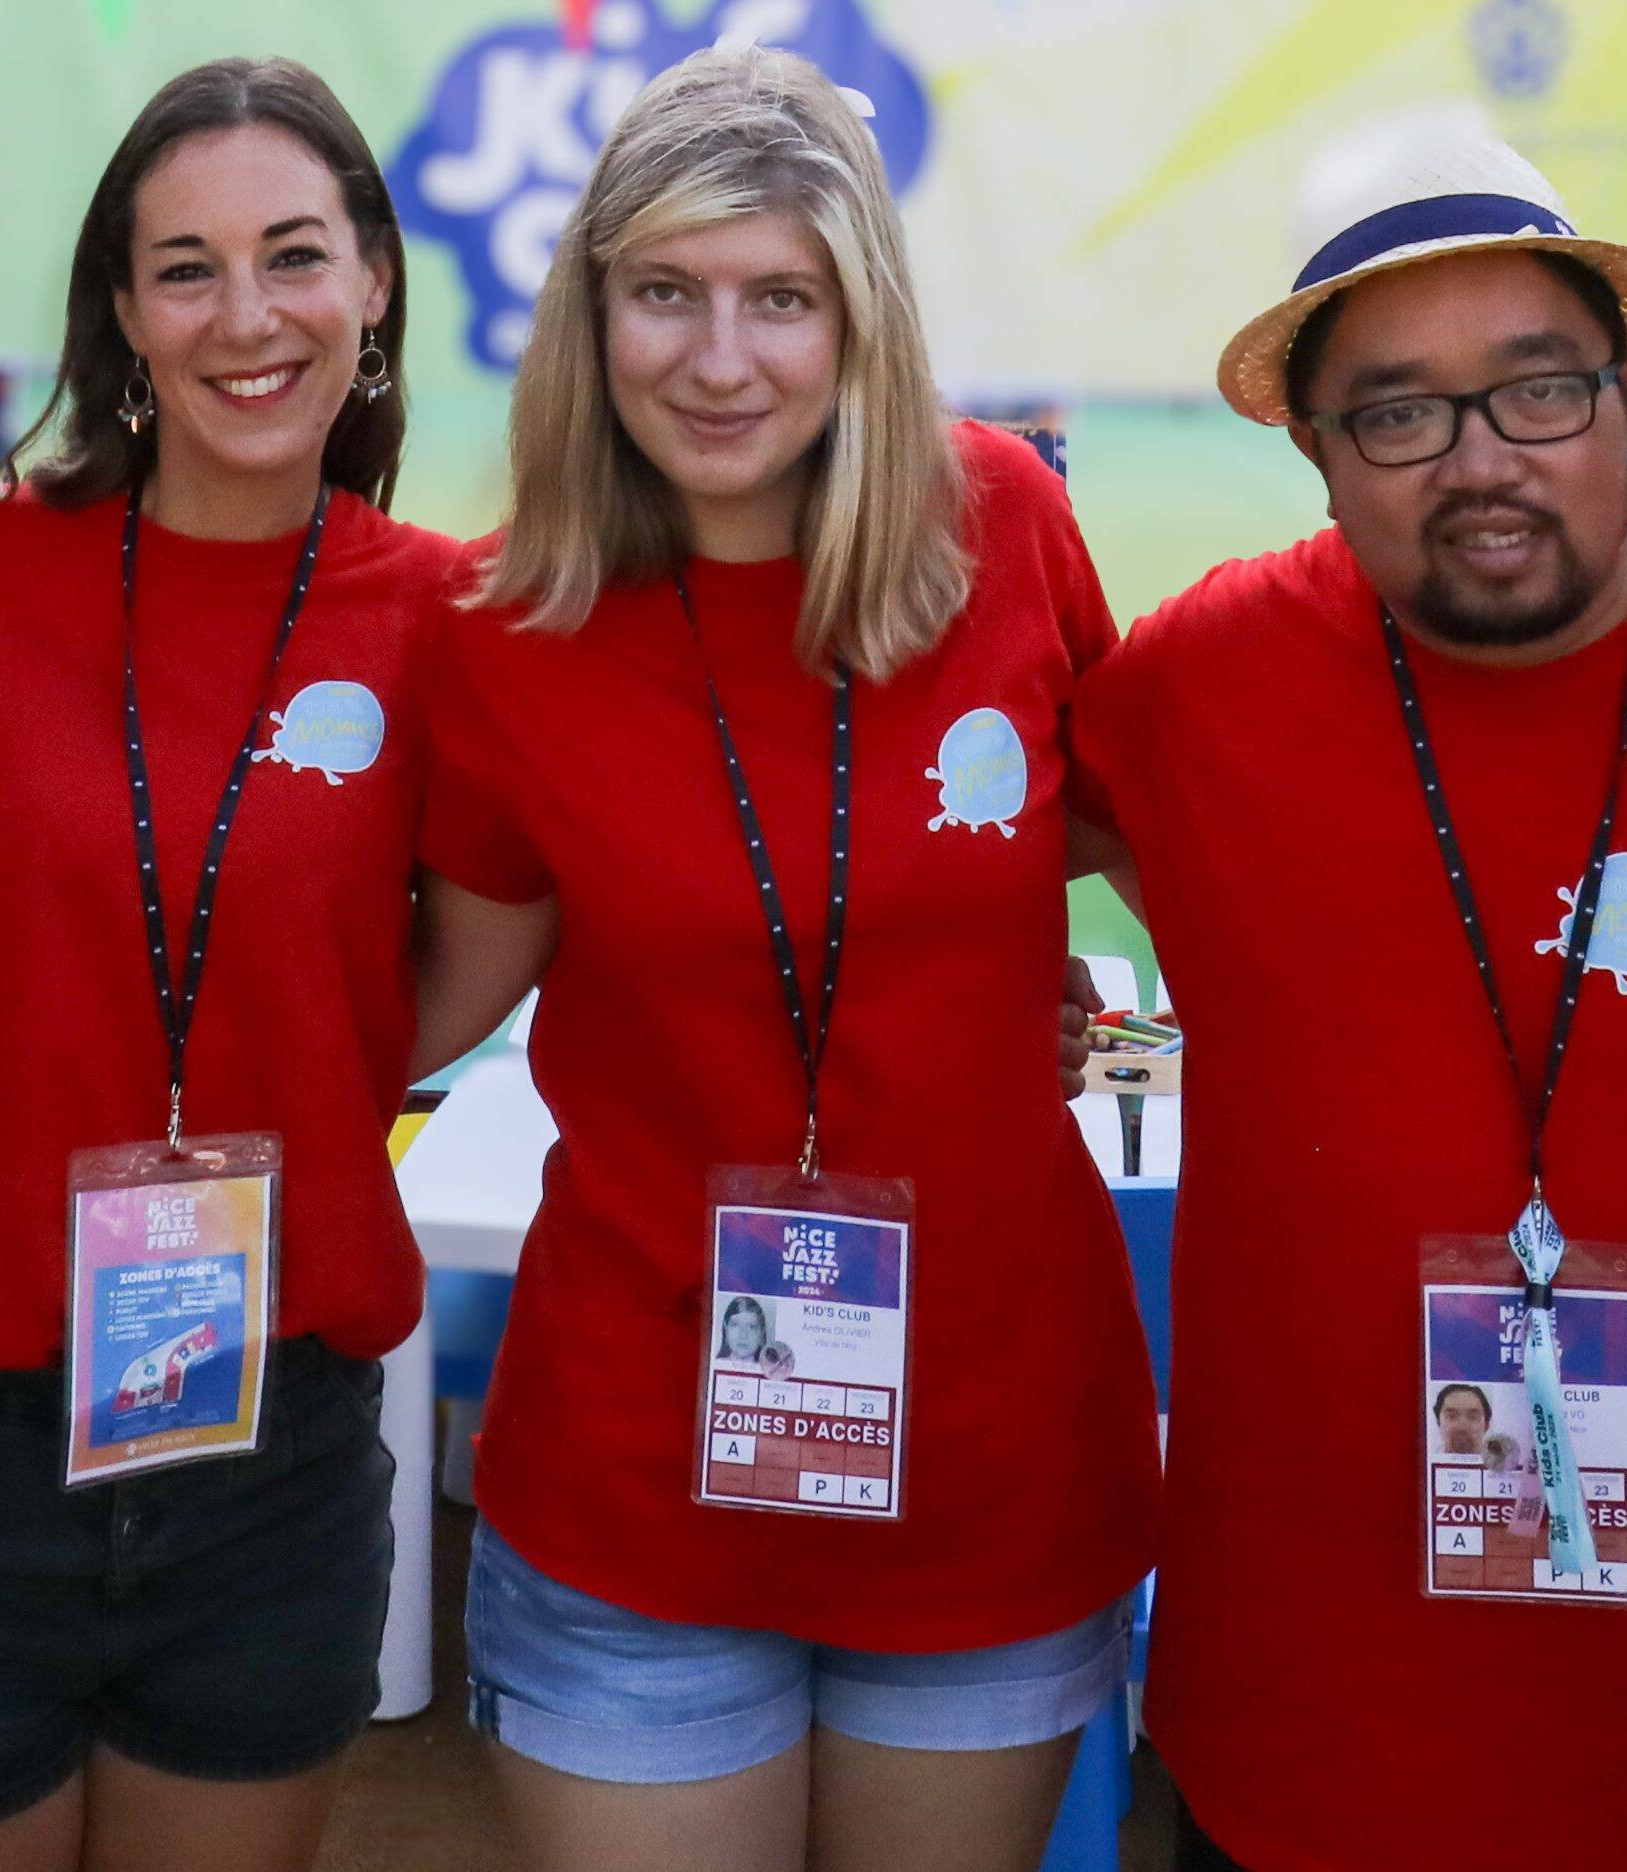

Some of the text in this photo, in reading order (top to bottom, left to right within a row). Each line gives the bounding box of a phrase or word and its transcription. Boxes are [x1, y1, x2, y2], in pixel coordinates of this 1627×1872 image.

[782, 1239, 839, 1268] JAZZ
[119, 1269, 164, 1286] ZONES
[803, 1304, 871, 1322] KID'S CLUB
[730, 1388, 874, 1415] 20 21 22 23
[1564, 1390, 1601, 1402] CLUB
[713, 1410, 891, 1446] ZONES D'ACCÈS
[1532, 1403, 1549, 1446] Club
[727, 1440, 740, 1458] A
[815, 1480, 873, 1499] P K
[1451, 1481, 1609, 1497] 20 21 23
[1436, 1503, 1514, 1524] ZONES
[1453, 1532, 1467, 1549] A
[1599, 1568, 1614, 1586] K
